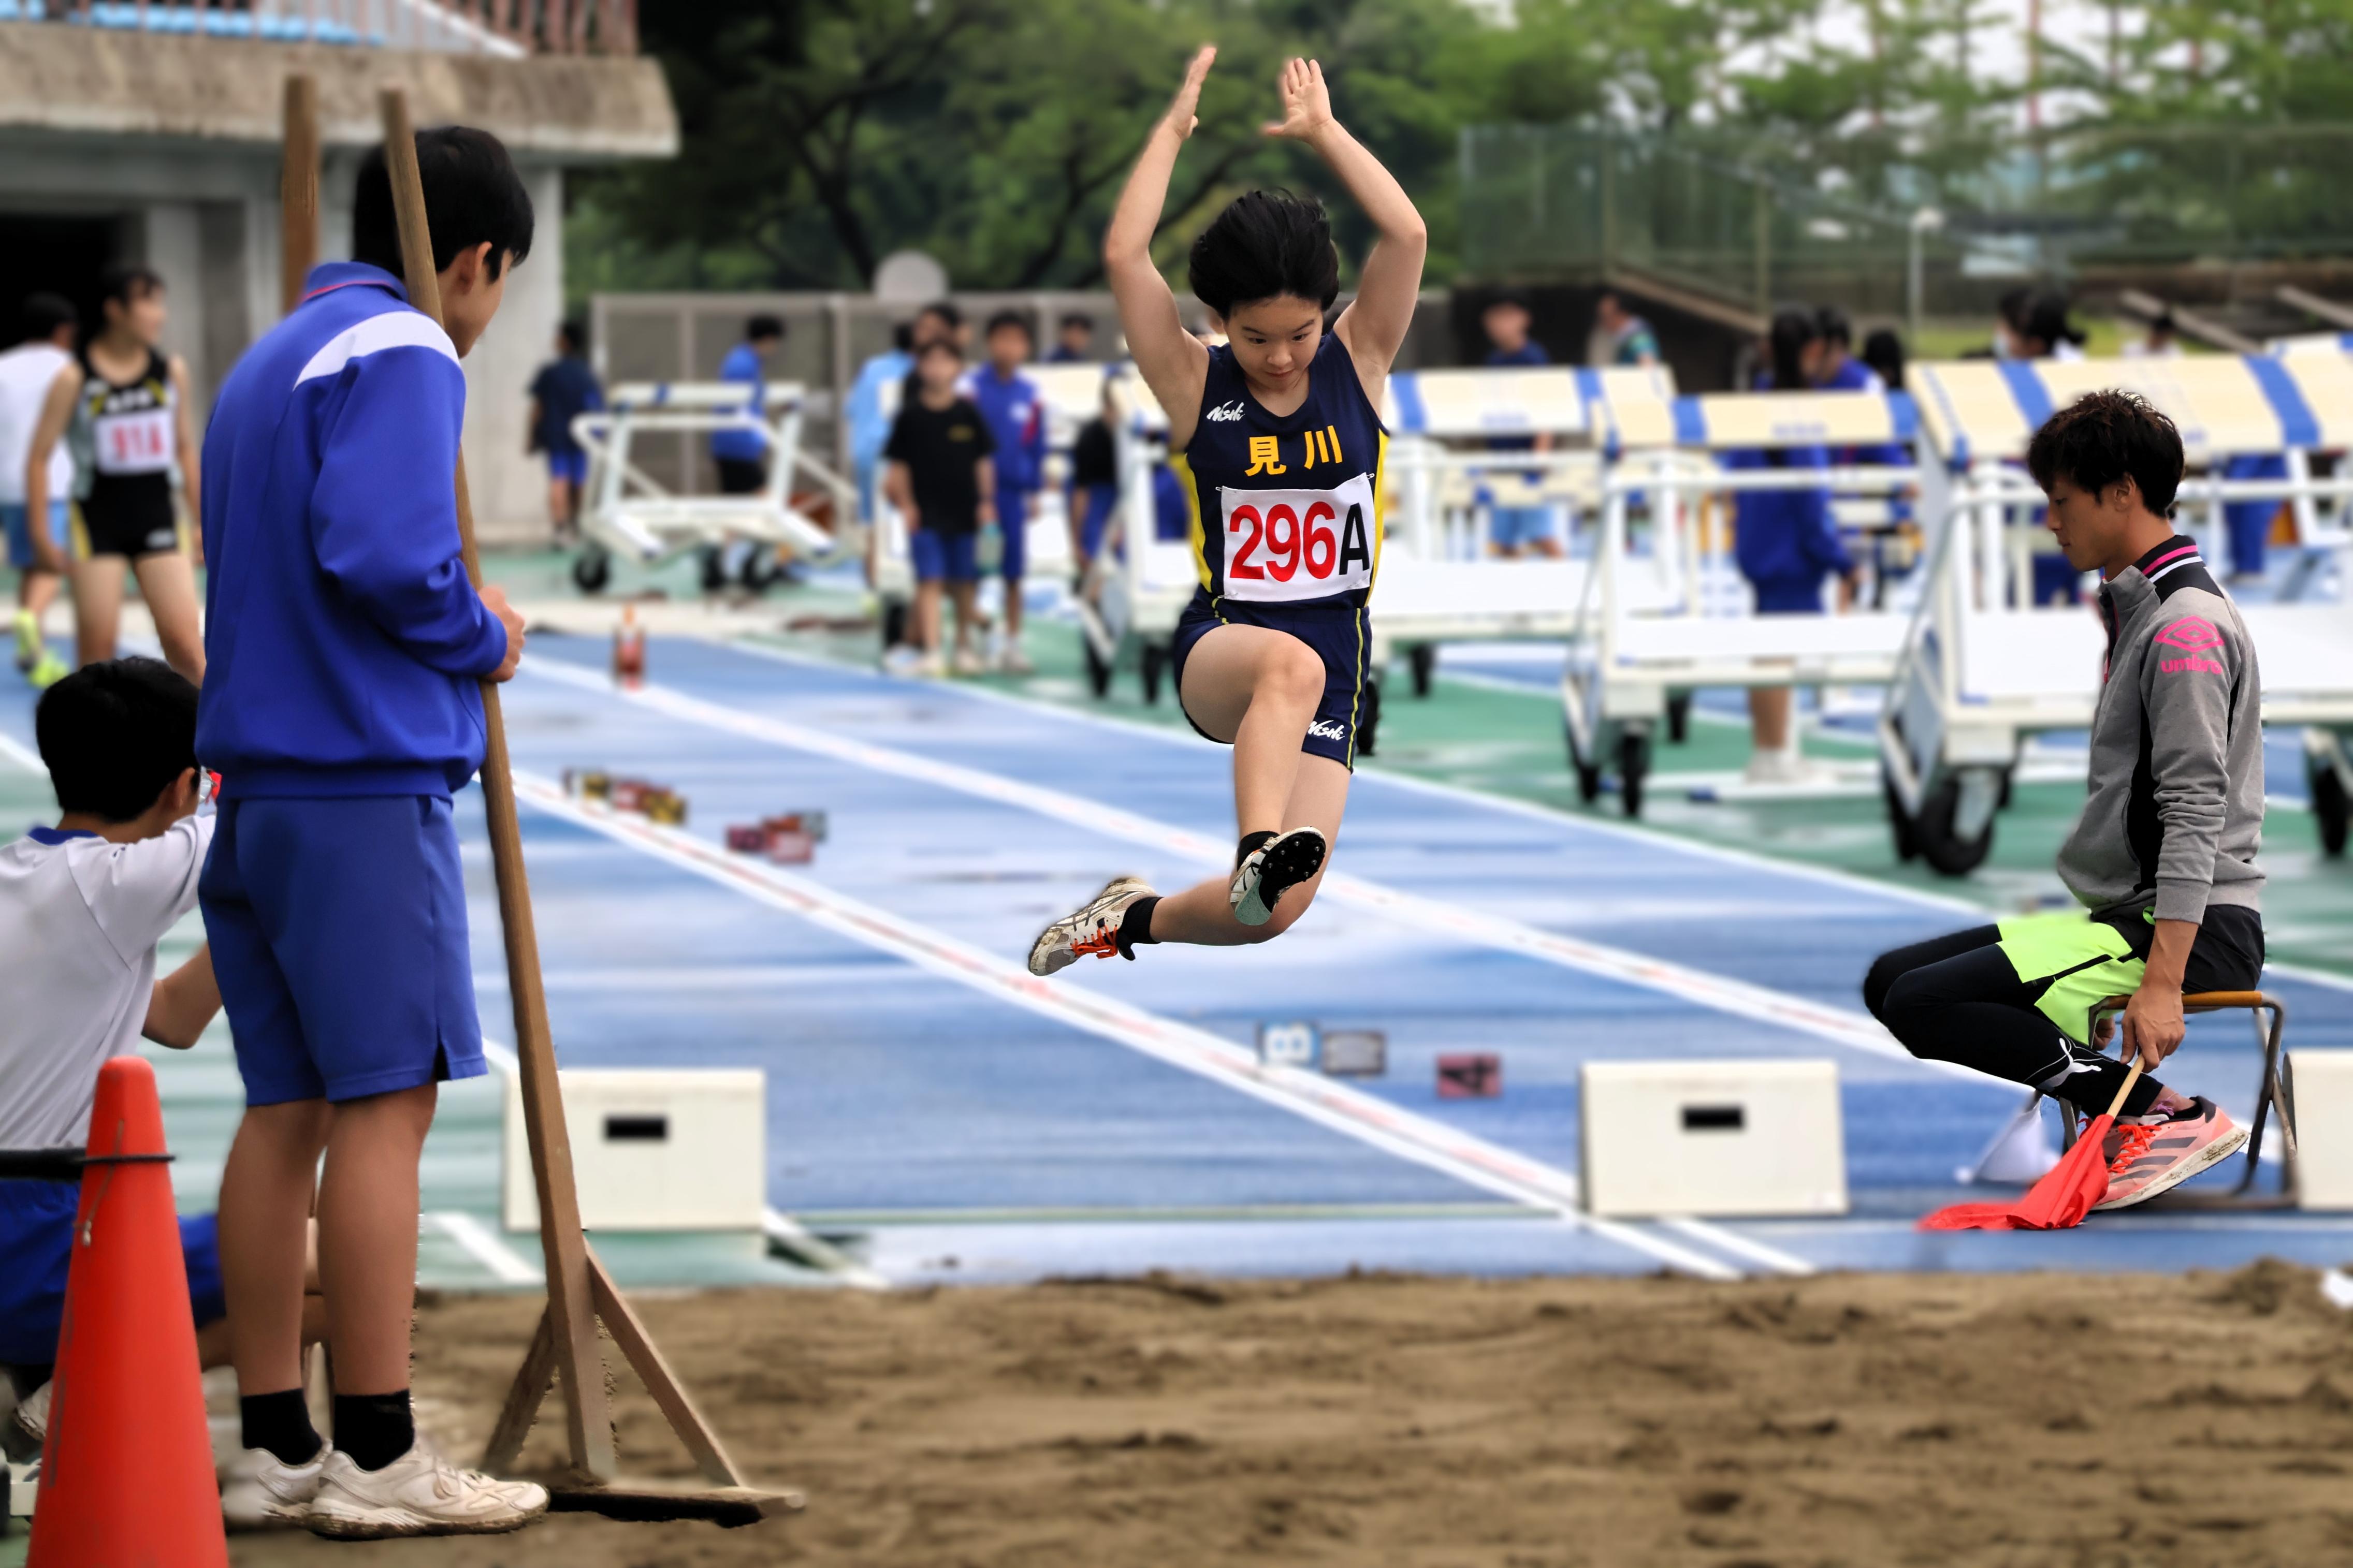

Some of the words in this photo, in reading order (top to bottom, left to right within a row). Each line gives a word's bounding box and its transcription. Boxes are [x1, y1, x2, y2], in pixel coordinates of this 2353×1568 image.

[1244, 424, 1343, 477] 見川
[1229, 501, 1370, 582] 296A
[2160, 654, 2223, 675] umbro
